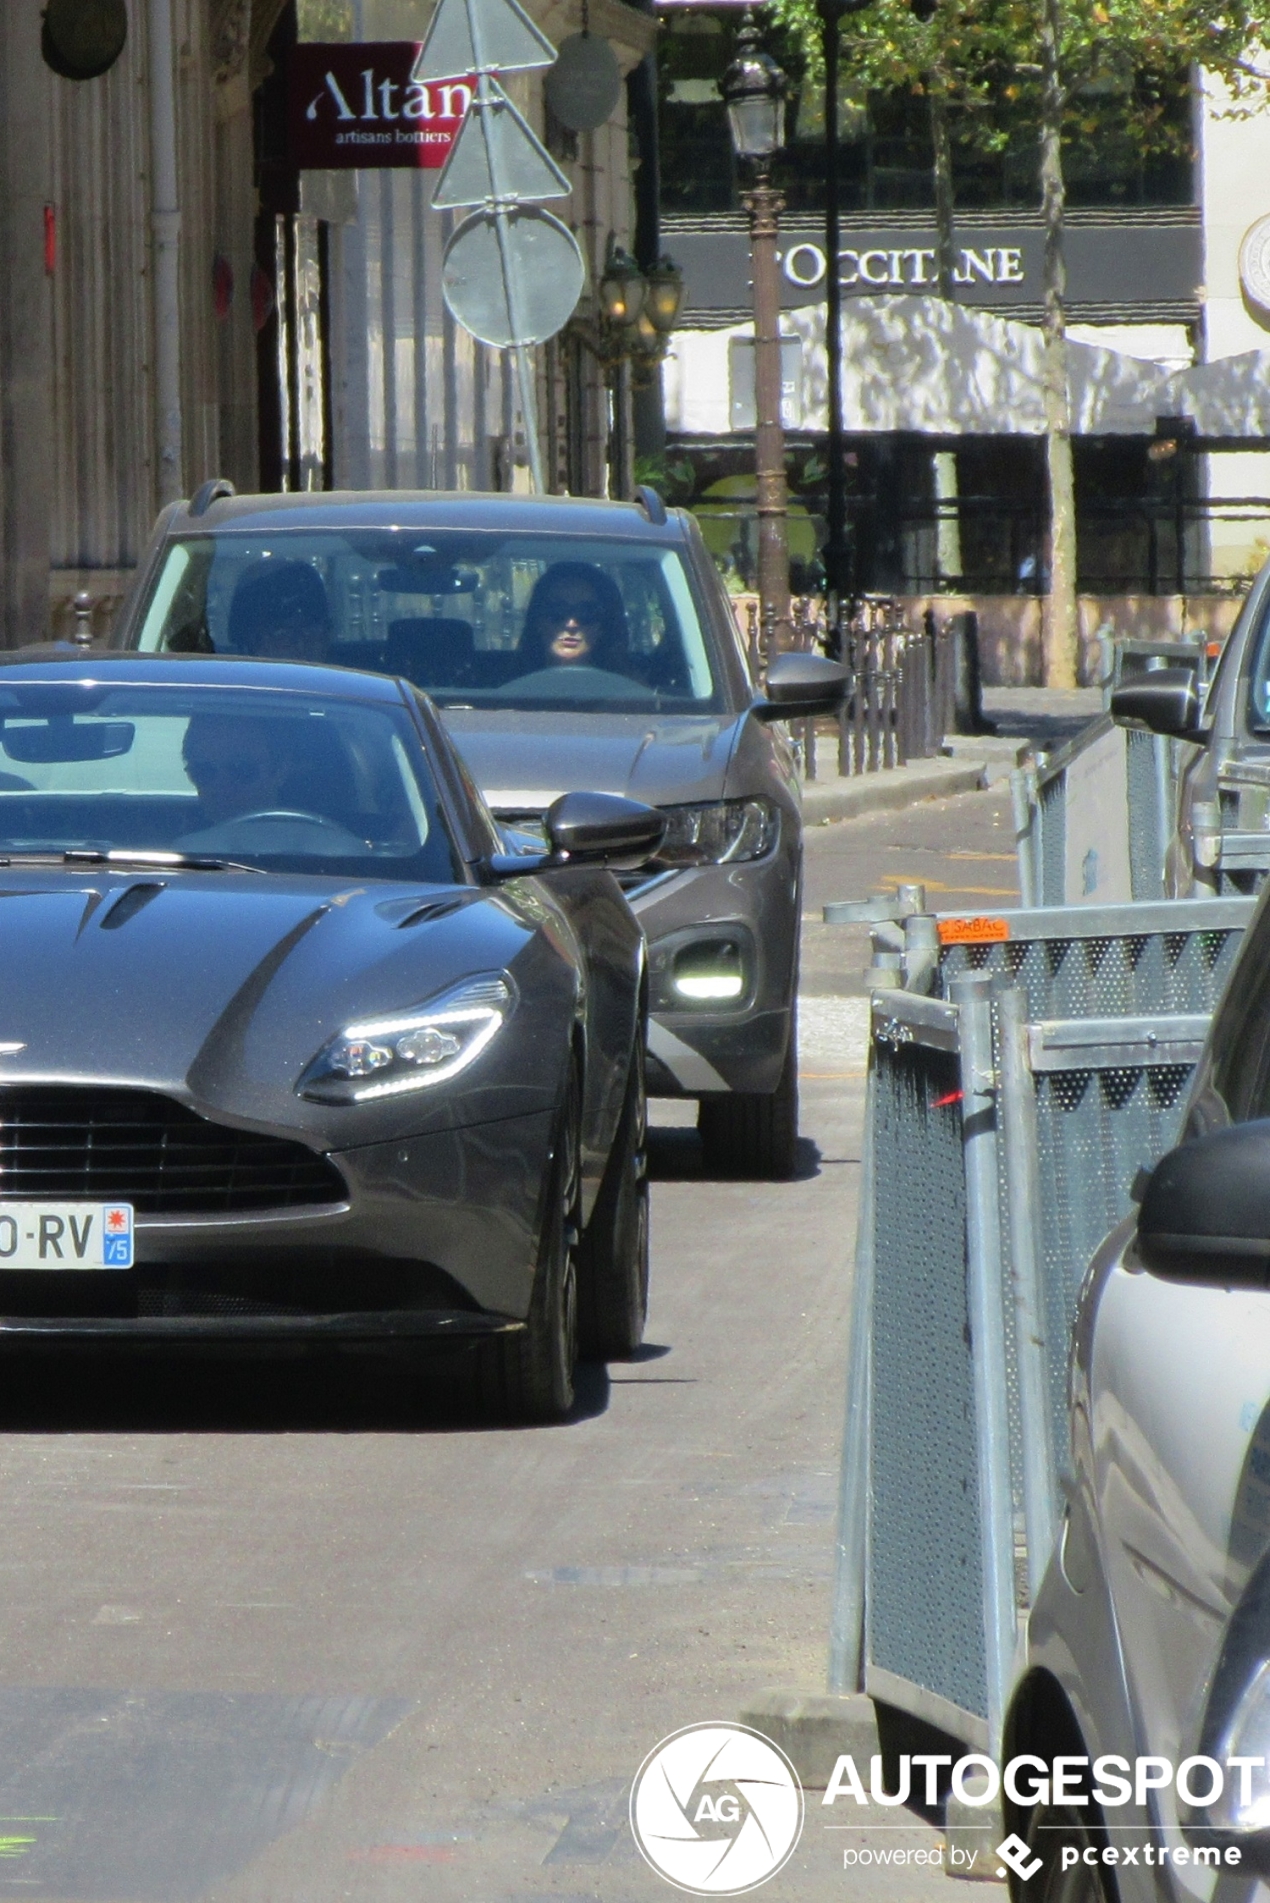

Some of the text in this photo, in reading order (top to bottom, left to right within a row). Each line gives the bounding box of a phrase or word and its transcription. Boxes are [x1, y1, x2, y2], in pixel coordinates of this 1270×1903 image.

[306, 68, 472, 120] Altan
[336, 128, 451, 144] artisans bottiers
[748, 243, 1024, 285] 'OCCITNE
